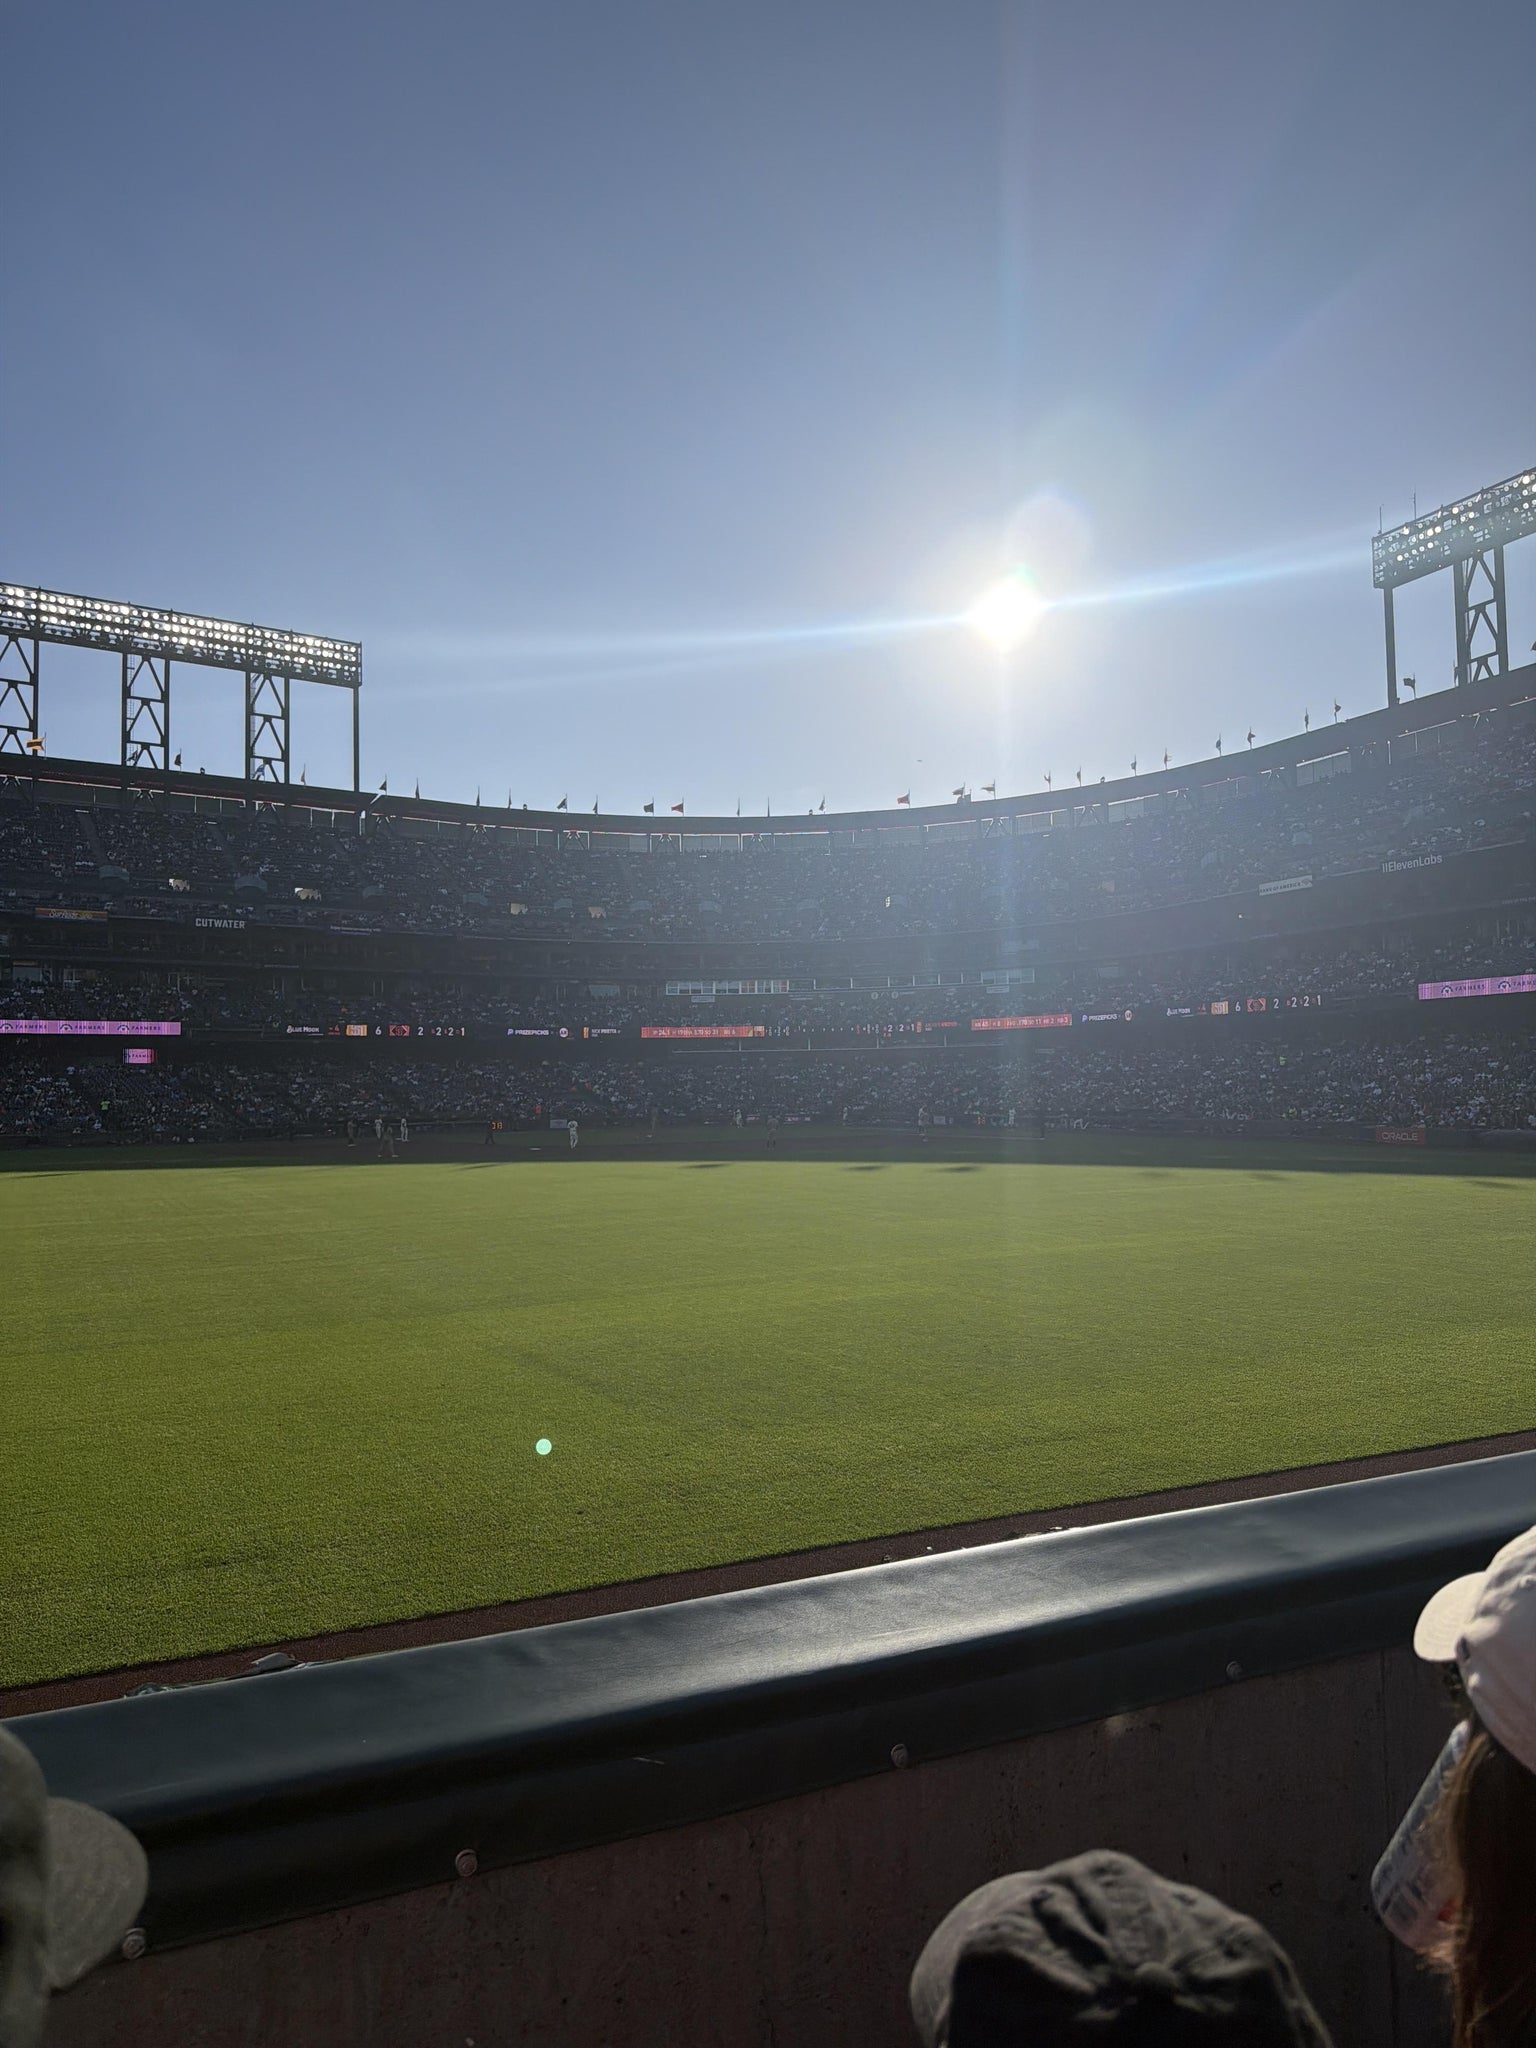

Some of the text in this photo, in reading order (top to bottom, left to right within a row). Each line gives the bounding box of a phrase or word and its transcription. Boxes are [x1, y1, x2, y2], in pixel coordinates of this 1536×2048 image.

[195, 918, 246, 929] CUTWATER
[1454, 983, 1485, 992] FARMERS
[1273, 998, 1279, 1009] 2
[1291, 994, 1321, 1008] 2 2 1
[1235, 1002, 1241, 1012] 6
[286, 1025, 302, 1034] BLUE
[375, 1025, 382, 1036] 6
[417, 1026, 424, 1036] 2
[435, 1026, 442, 1036] 2
[448, 1026, 454, 1036] 2
[460, 1026, 465, 1036] 1
[887, 1024, 893, 1032] 2
[898, 1023, 904, 1032] 2
[1381, 1131, 1419, 1141] ORACLE
